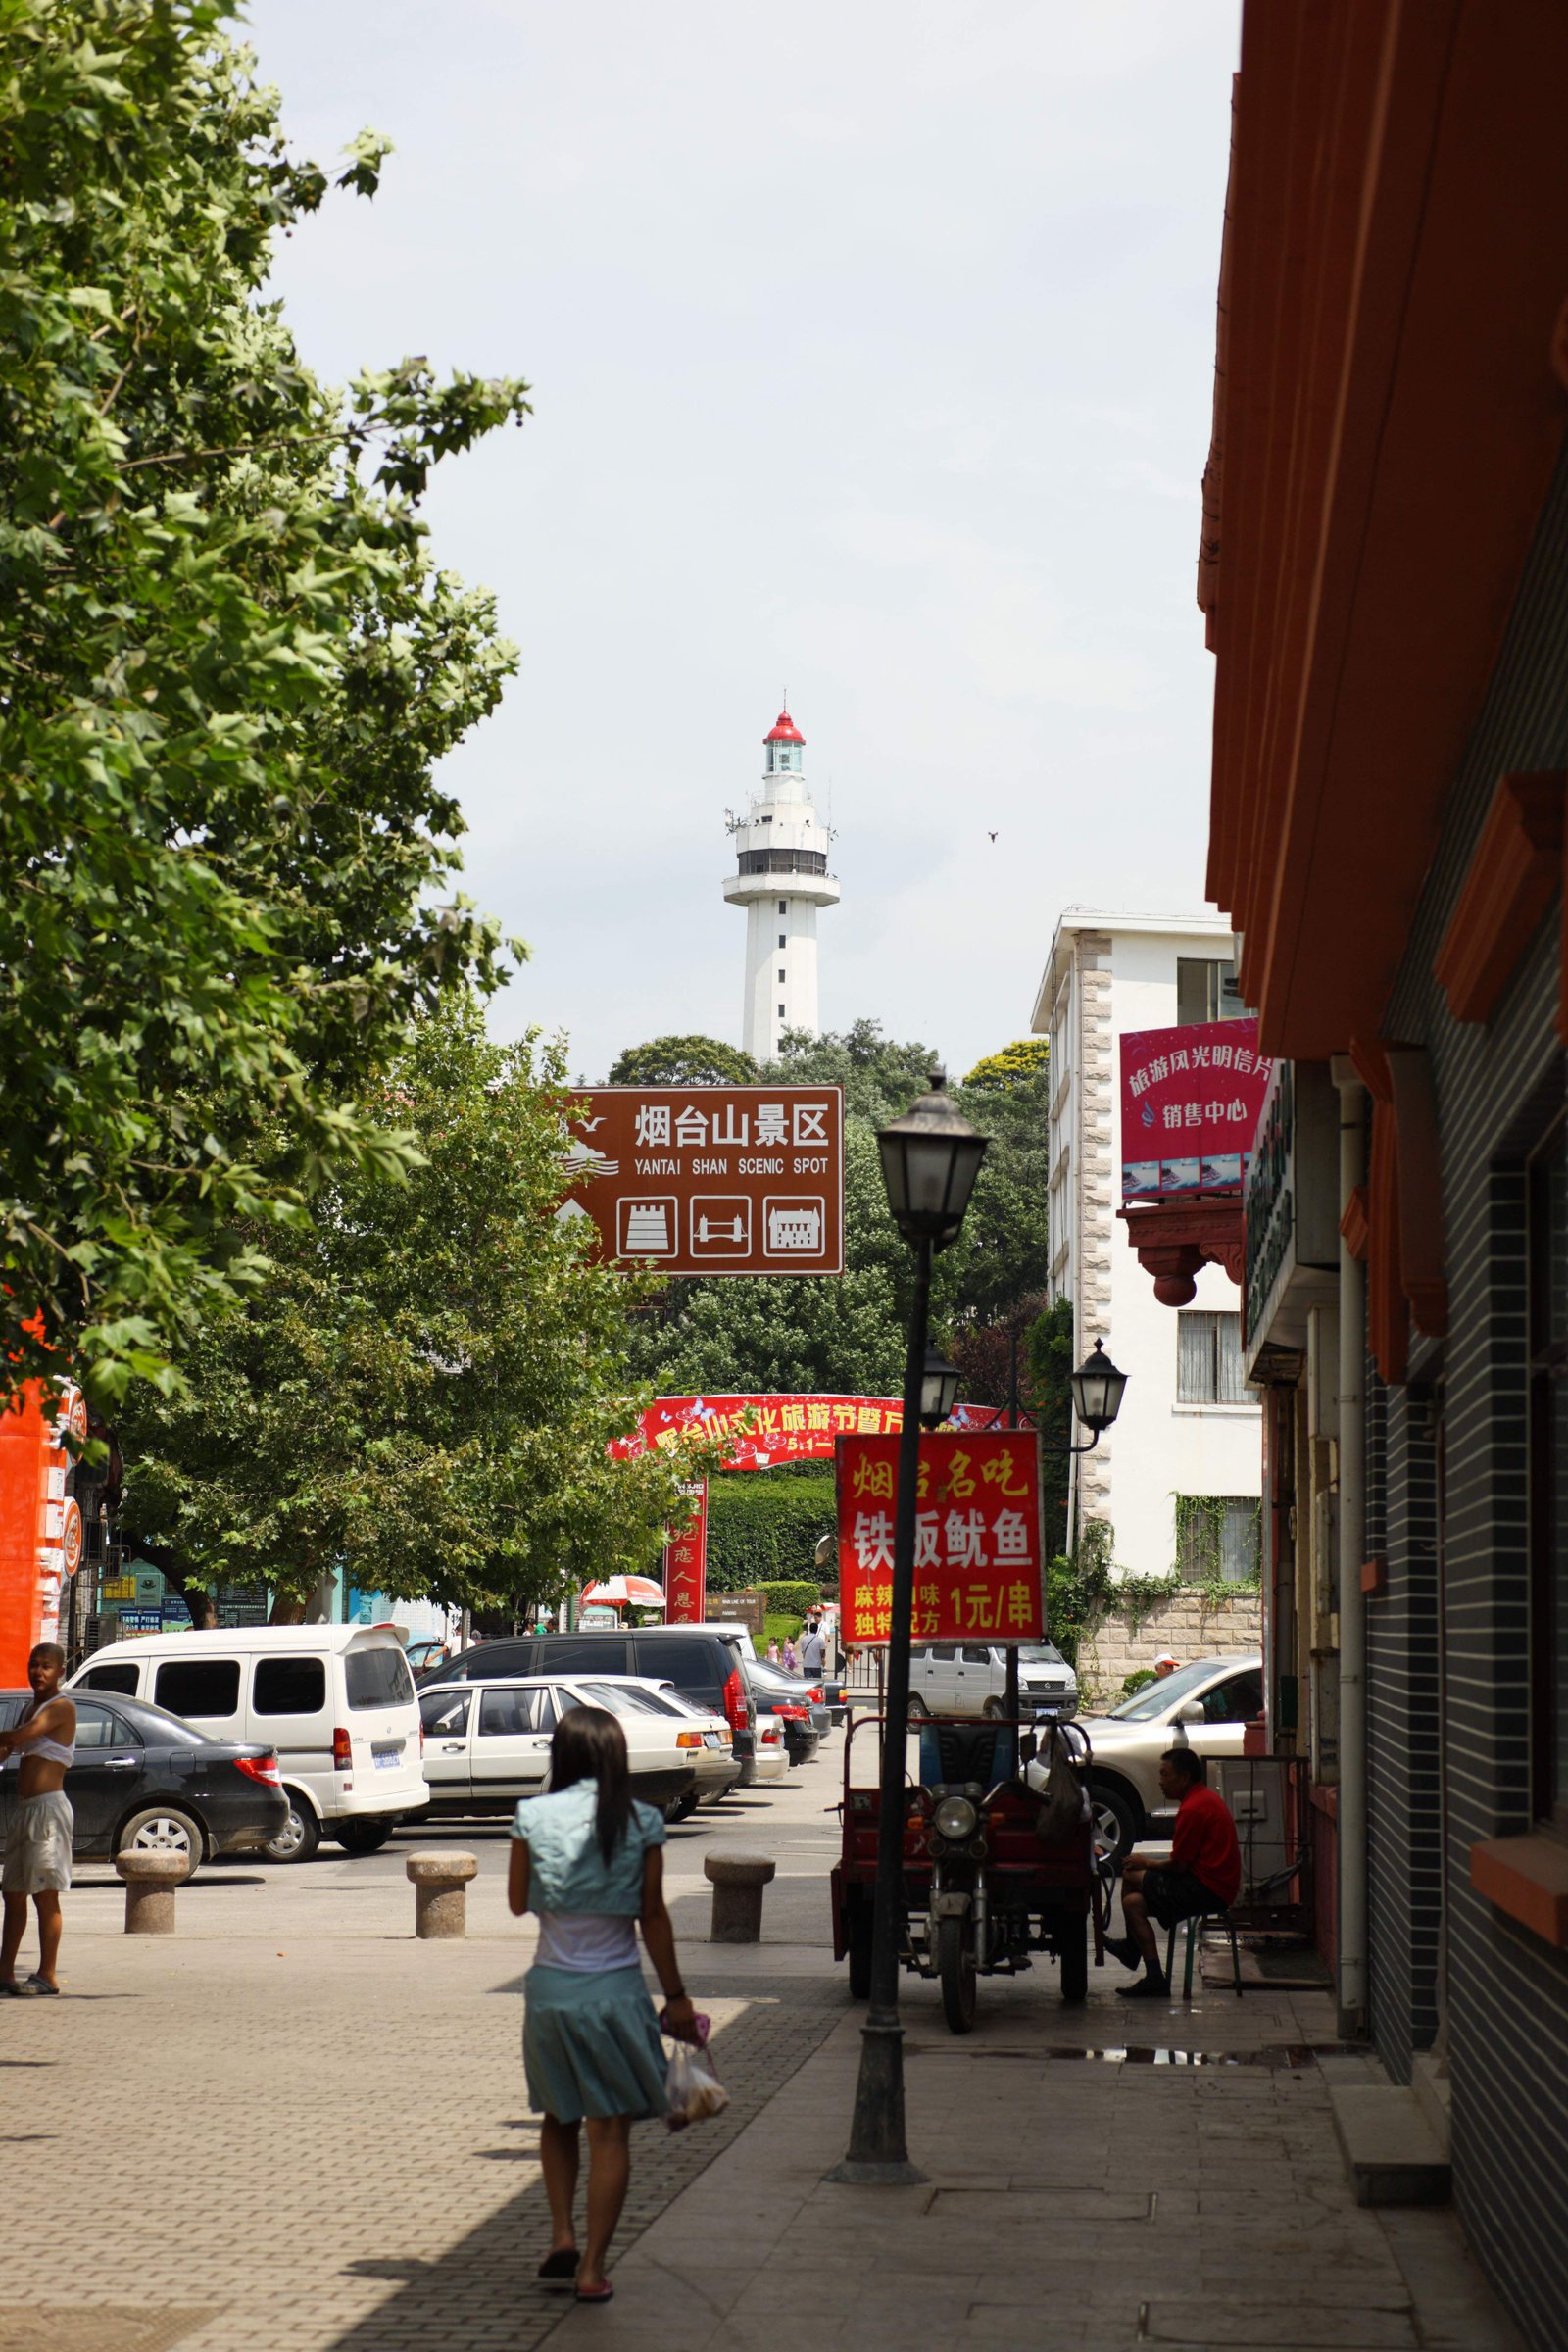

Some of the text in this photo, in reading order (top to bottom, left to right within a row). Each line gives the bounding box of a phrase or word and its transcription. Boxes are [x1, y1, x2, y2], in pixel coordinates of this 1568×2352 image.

[1129, 1045, 1273, 1097] 旅游风光明信片
[635, 1103, 829, 1148] 烟台山景区
[1162, 1098, 1248, 1129] 销售中心
[634, 1157, 829, 1175] YANTAI SHAN SCENIC SPOT
[654, 1402, 958, 1451] 烟台山文化旅游节暨万
[855, 1583, 941, 1608] 麻辣味
[950, 1579, 1033, 1629] 1元/串
